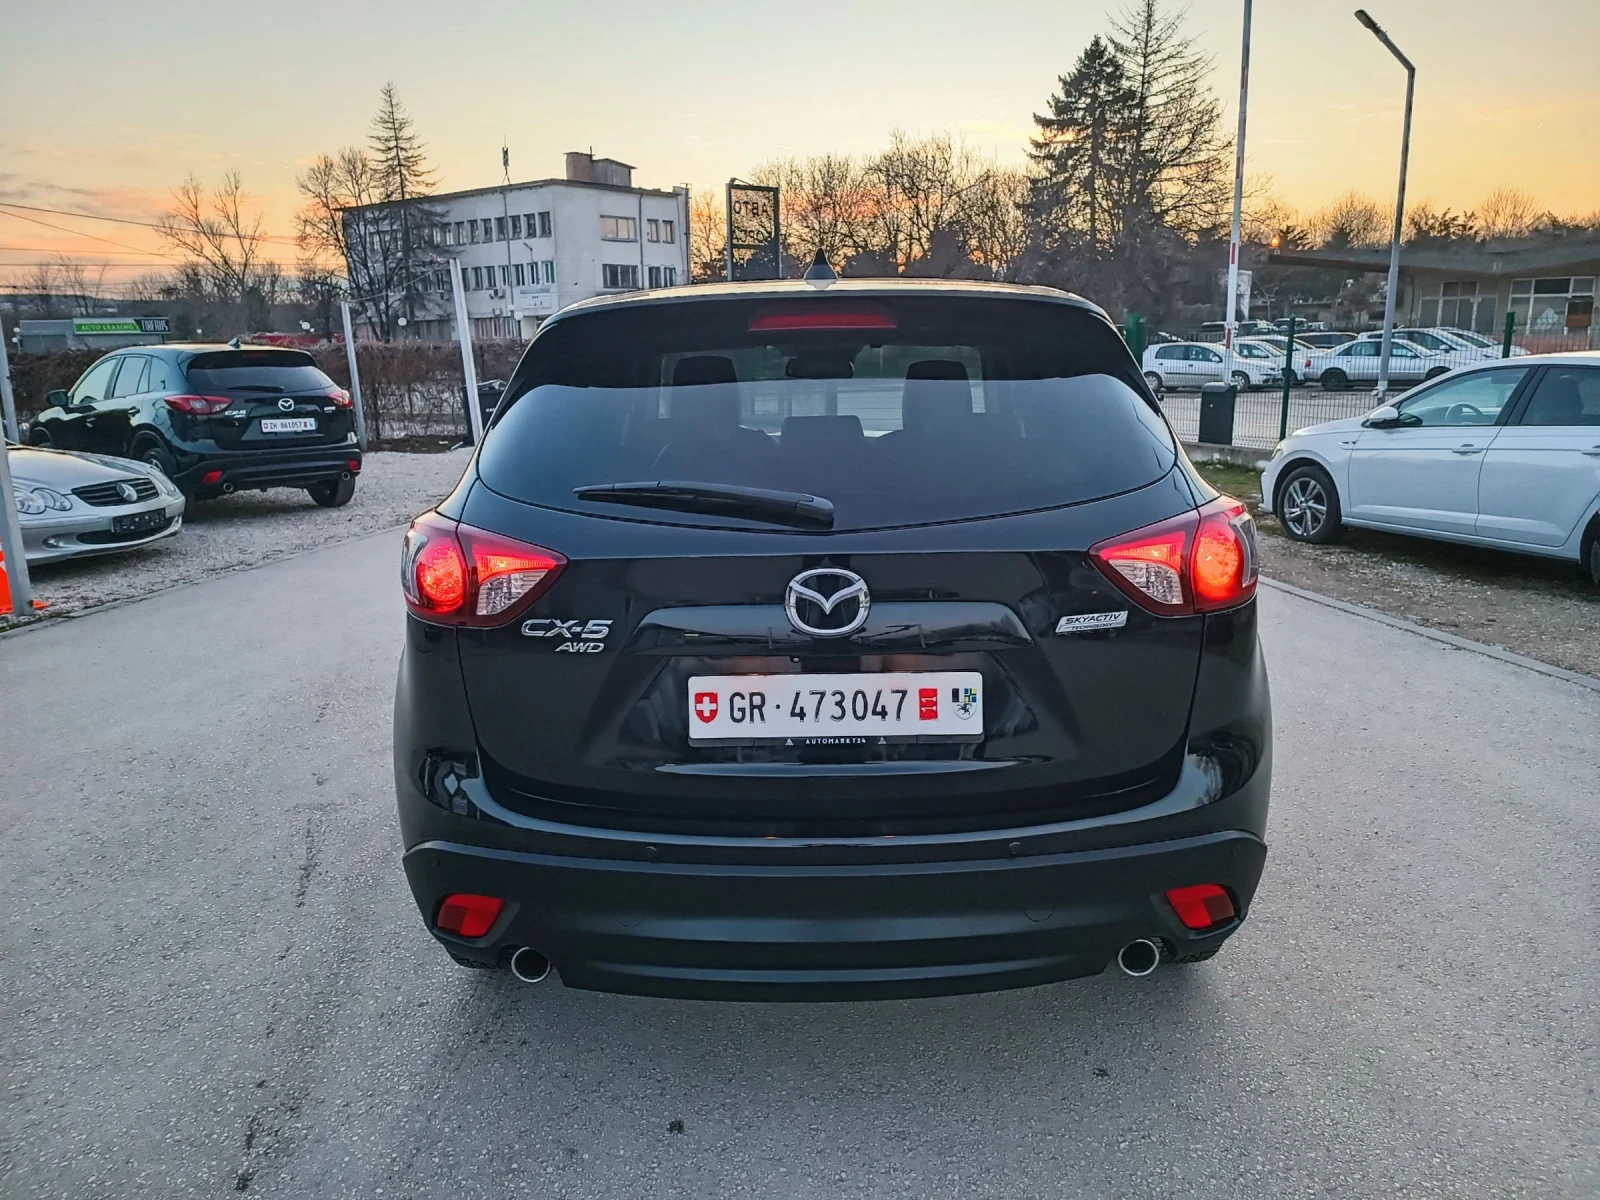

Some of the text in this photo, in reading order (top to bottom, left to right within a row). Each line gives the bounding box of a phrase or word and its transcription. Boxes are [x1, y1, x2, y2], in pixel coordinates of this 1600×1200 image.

[81, 323, 101, 331] AUTO
[1065, 613, 1122, 625] SKYACTIV
[521, 618, 614, 639] CX-5
[1072, 622, 1114, 631] TECHNOLOGY
[554, 641, 605, 653] AWD
[805, 737, 866, 745] AUTOMARKT24
